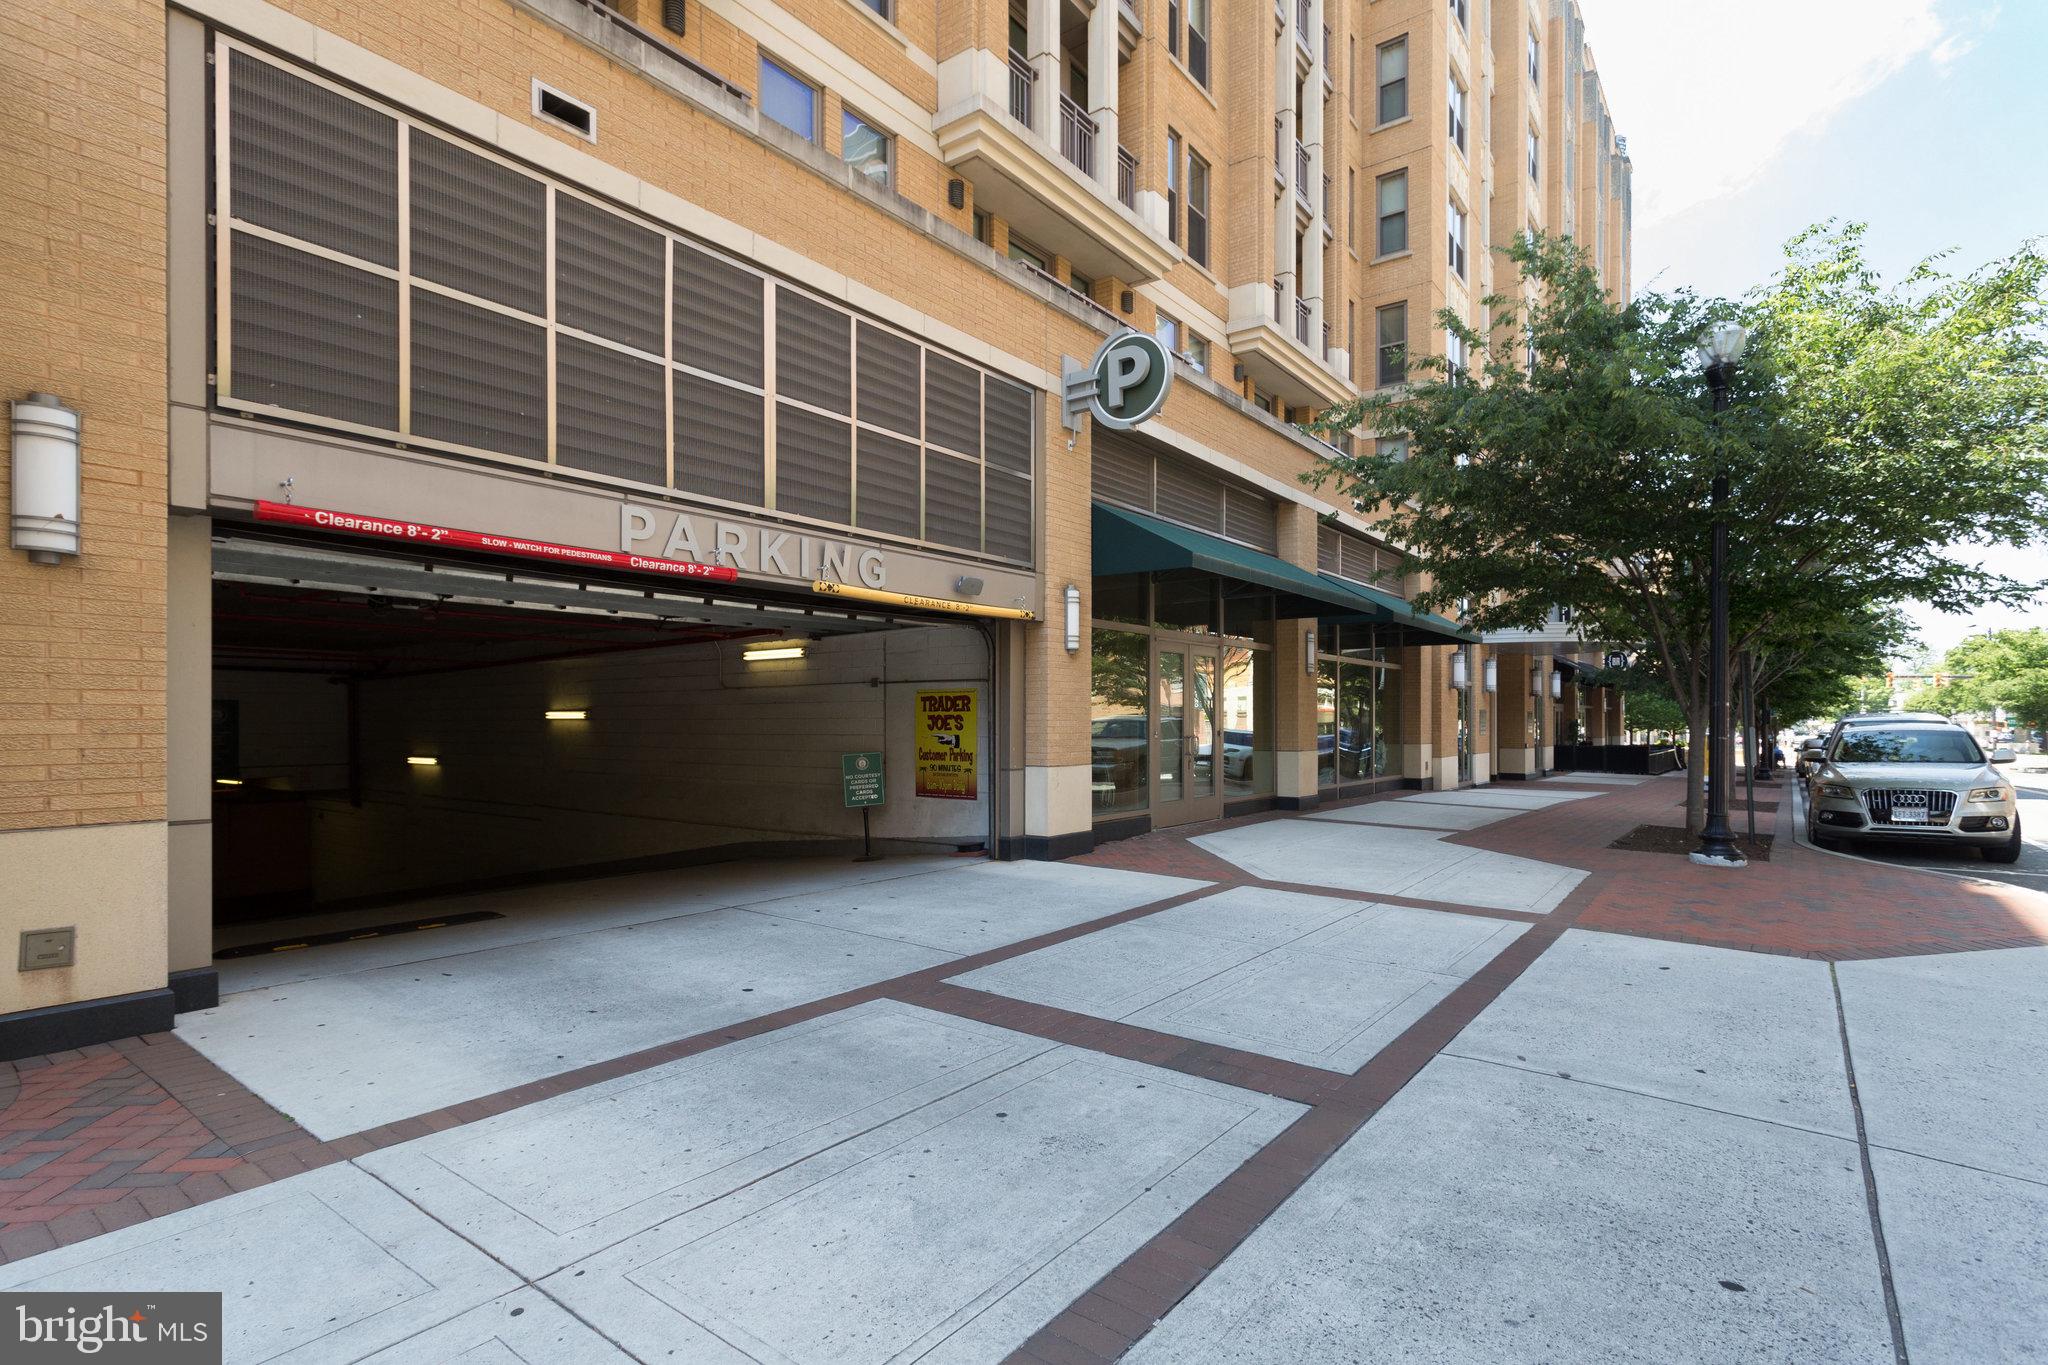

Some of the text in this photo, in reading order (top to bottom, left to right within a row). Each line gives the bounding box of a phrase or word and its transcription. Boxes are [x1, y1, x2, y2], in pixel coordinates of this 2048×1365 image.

[1108, 345, 1150, 408] P
[315, 511, 403, 535] Clearance
[482, 537, 507, 548] SLOW
[513, 542, 542, 552] WATCH
[544, 545, 560, 556] FOR
[561, 548, 612, 562] PEDESTRIANS
[620, 503, 887, 590] PARKING
[630, 557, 686, 574] Clearance
[903, 596, 951, 610] CLEARANCE
[920, 694, 972, 712] TRADER
[927, 714, 964, 731] JOE'S
[918, 747, 973, 766] Customer Parking
[938, 764, 962, 772] MINUTES
